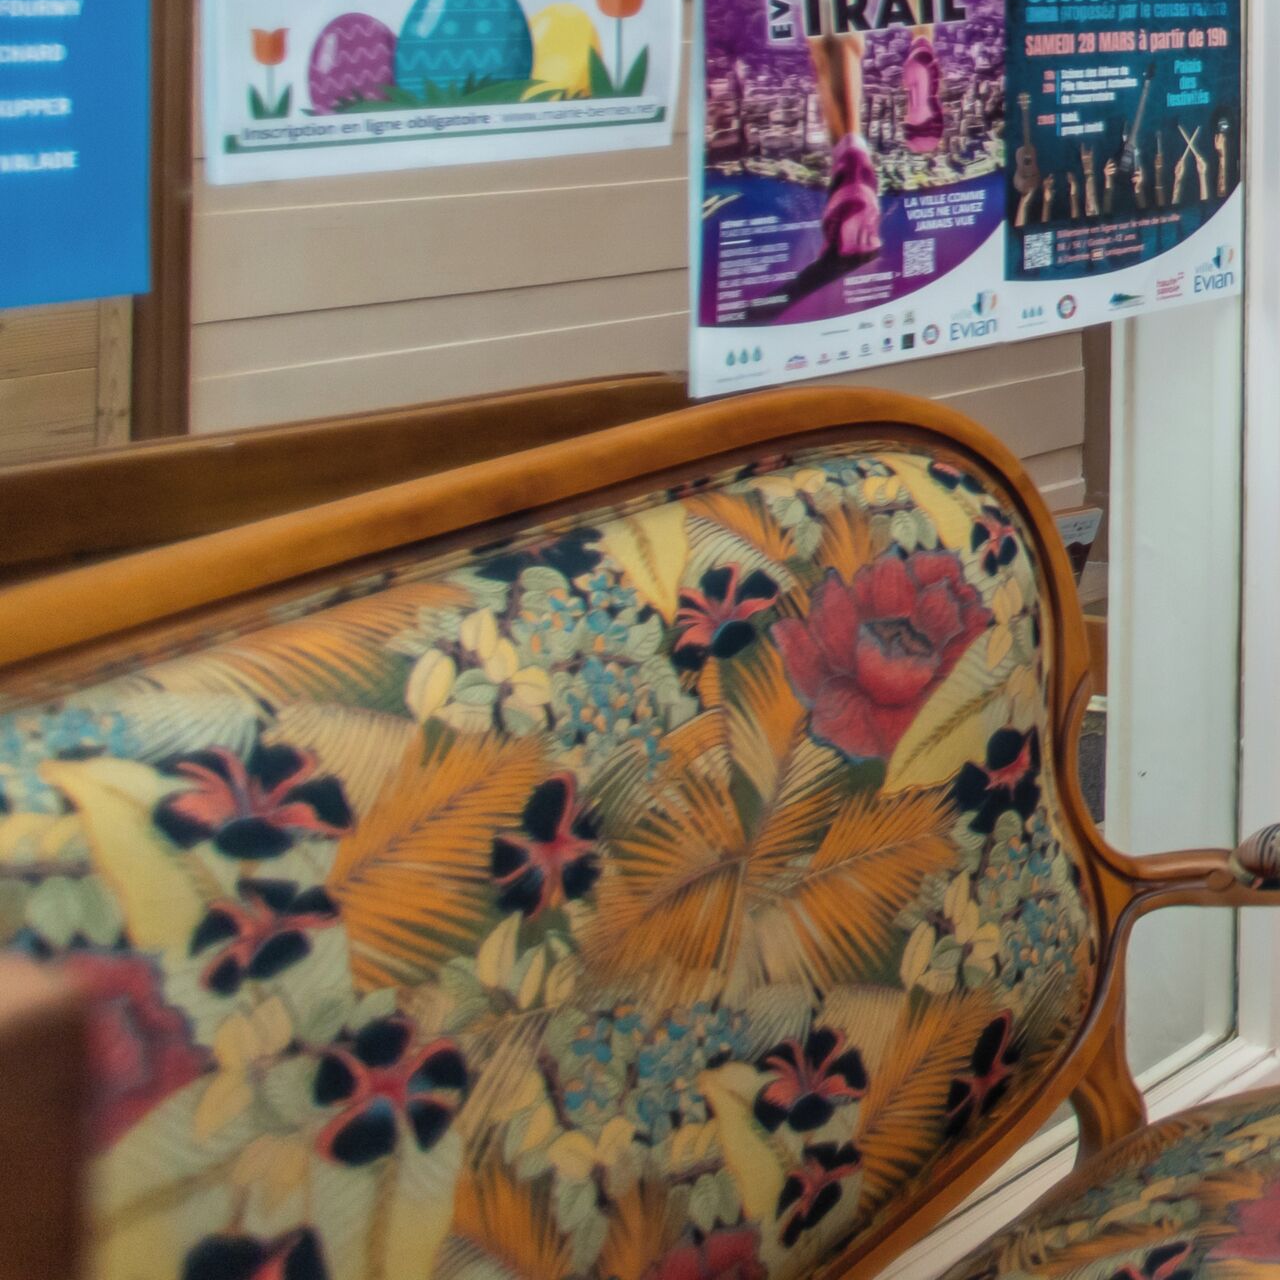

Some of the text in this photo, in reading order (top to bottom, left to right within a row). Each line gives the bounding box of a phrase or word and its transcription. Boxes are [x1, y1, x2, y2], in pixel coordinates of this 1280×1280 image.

[1025, 26, 1229, 56] SAMEDI 28 MARS à partir de 19h
[1178, 75, 1198, 90] des
[243, 111, 493, 141] Inscription en ligne obligatoire
[904, 196, 918, 208] LA
[1194, 271, 1235, 294] Evian
[950, 317, 998, 342] Evian
